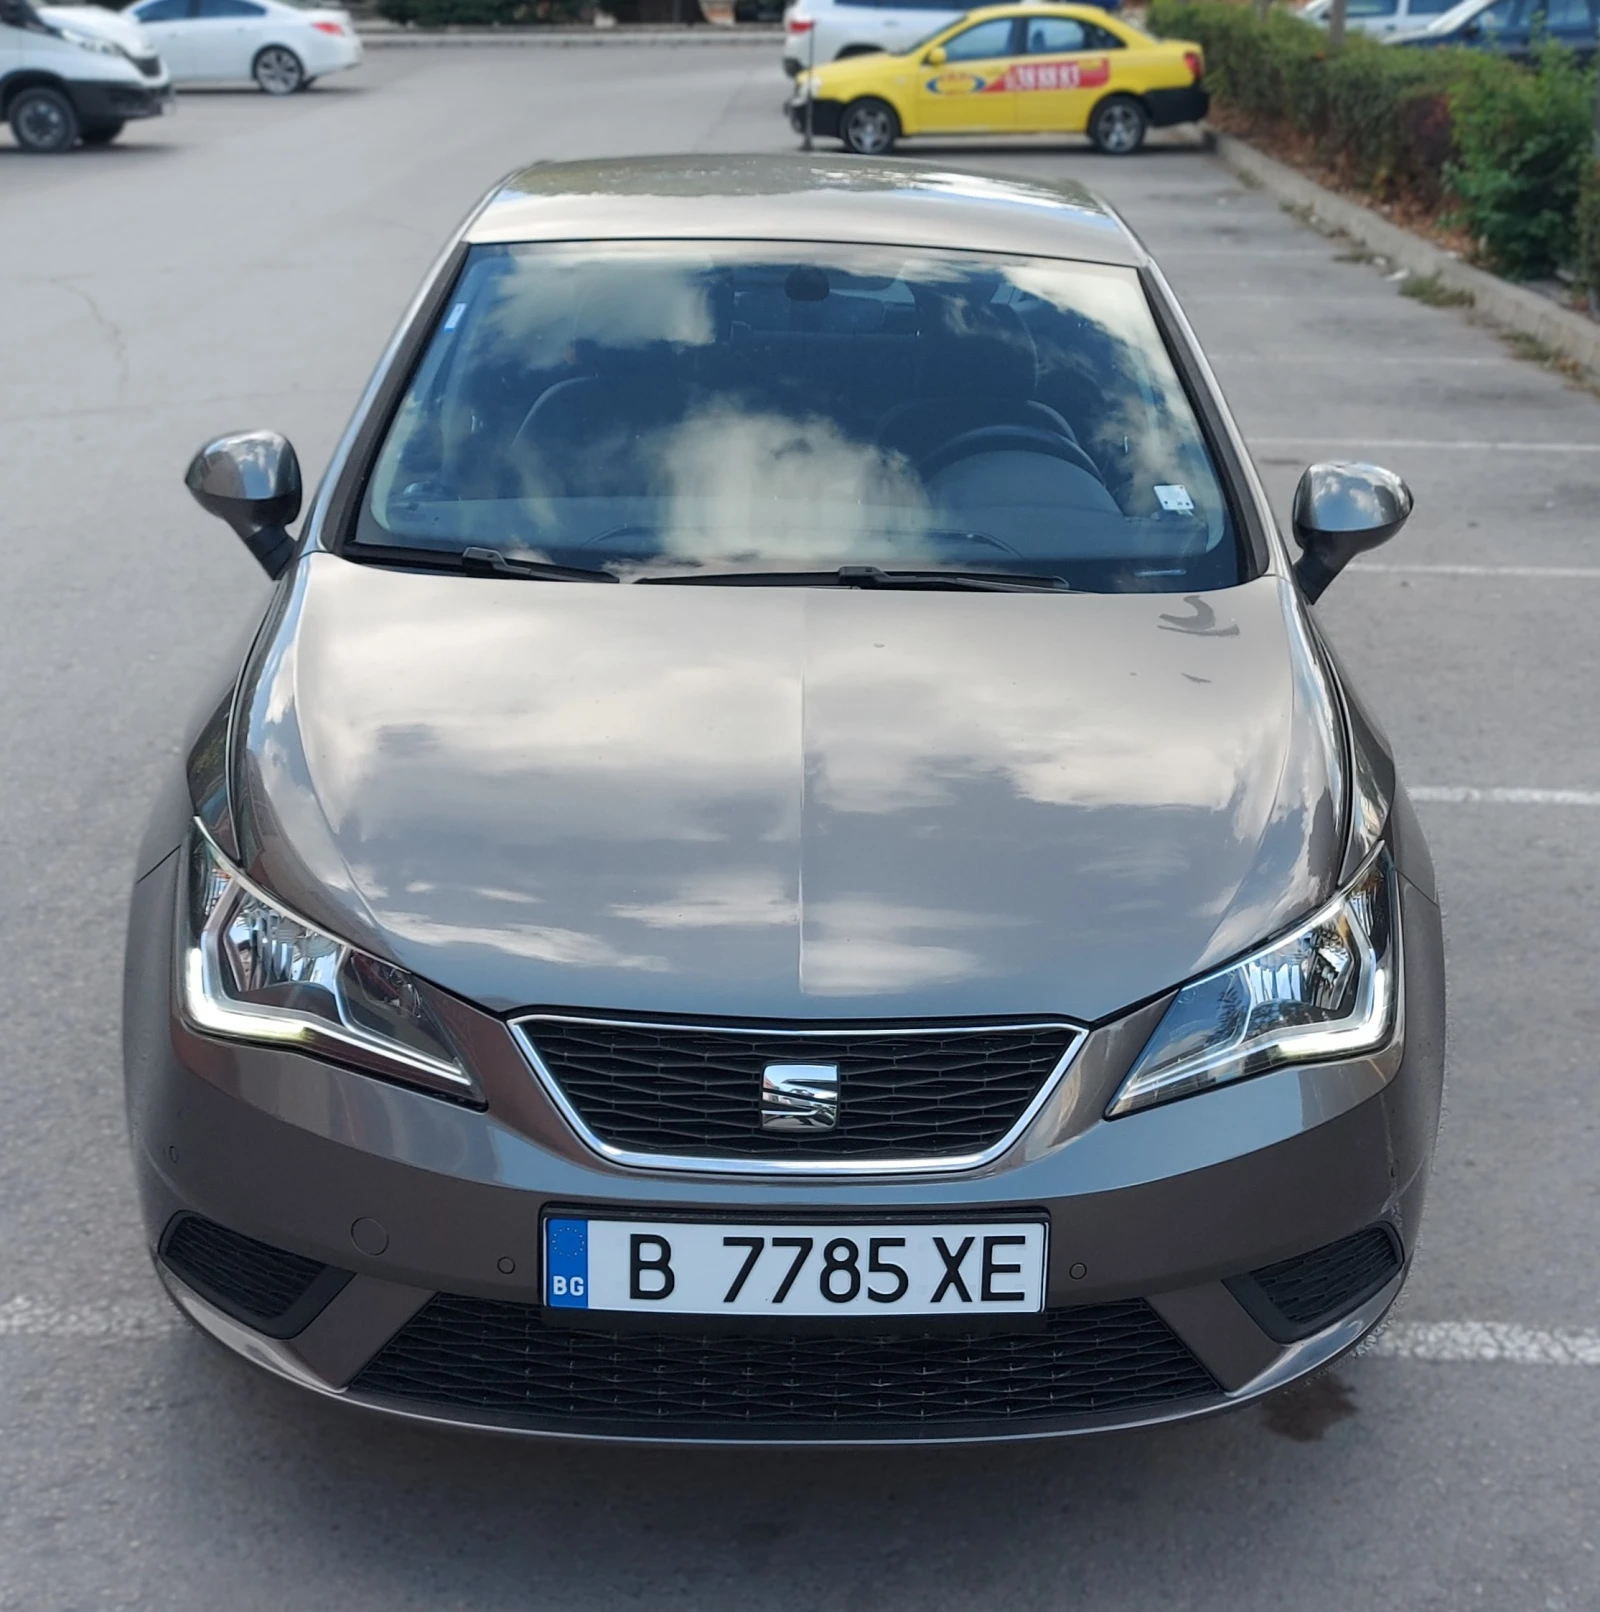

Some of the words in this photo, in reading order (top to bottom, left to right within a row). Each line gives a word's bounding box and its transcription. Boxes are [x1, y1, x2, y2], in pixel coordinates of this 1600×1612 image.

[553, 1275, 584, 1296] BG
[629, 1234, 675, 1300] B
[723, 1237, 909, 1303] 7785
[930, 1235, 1026, 1302] XE
